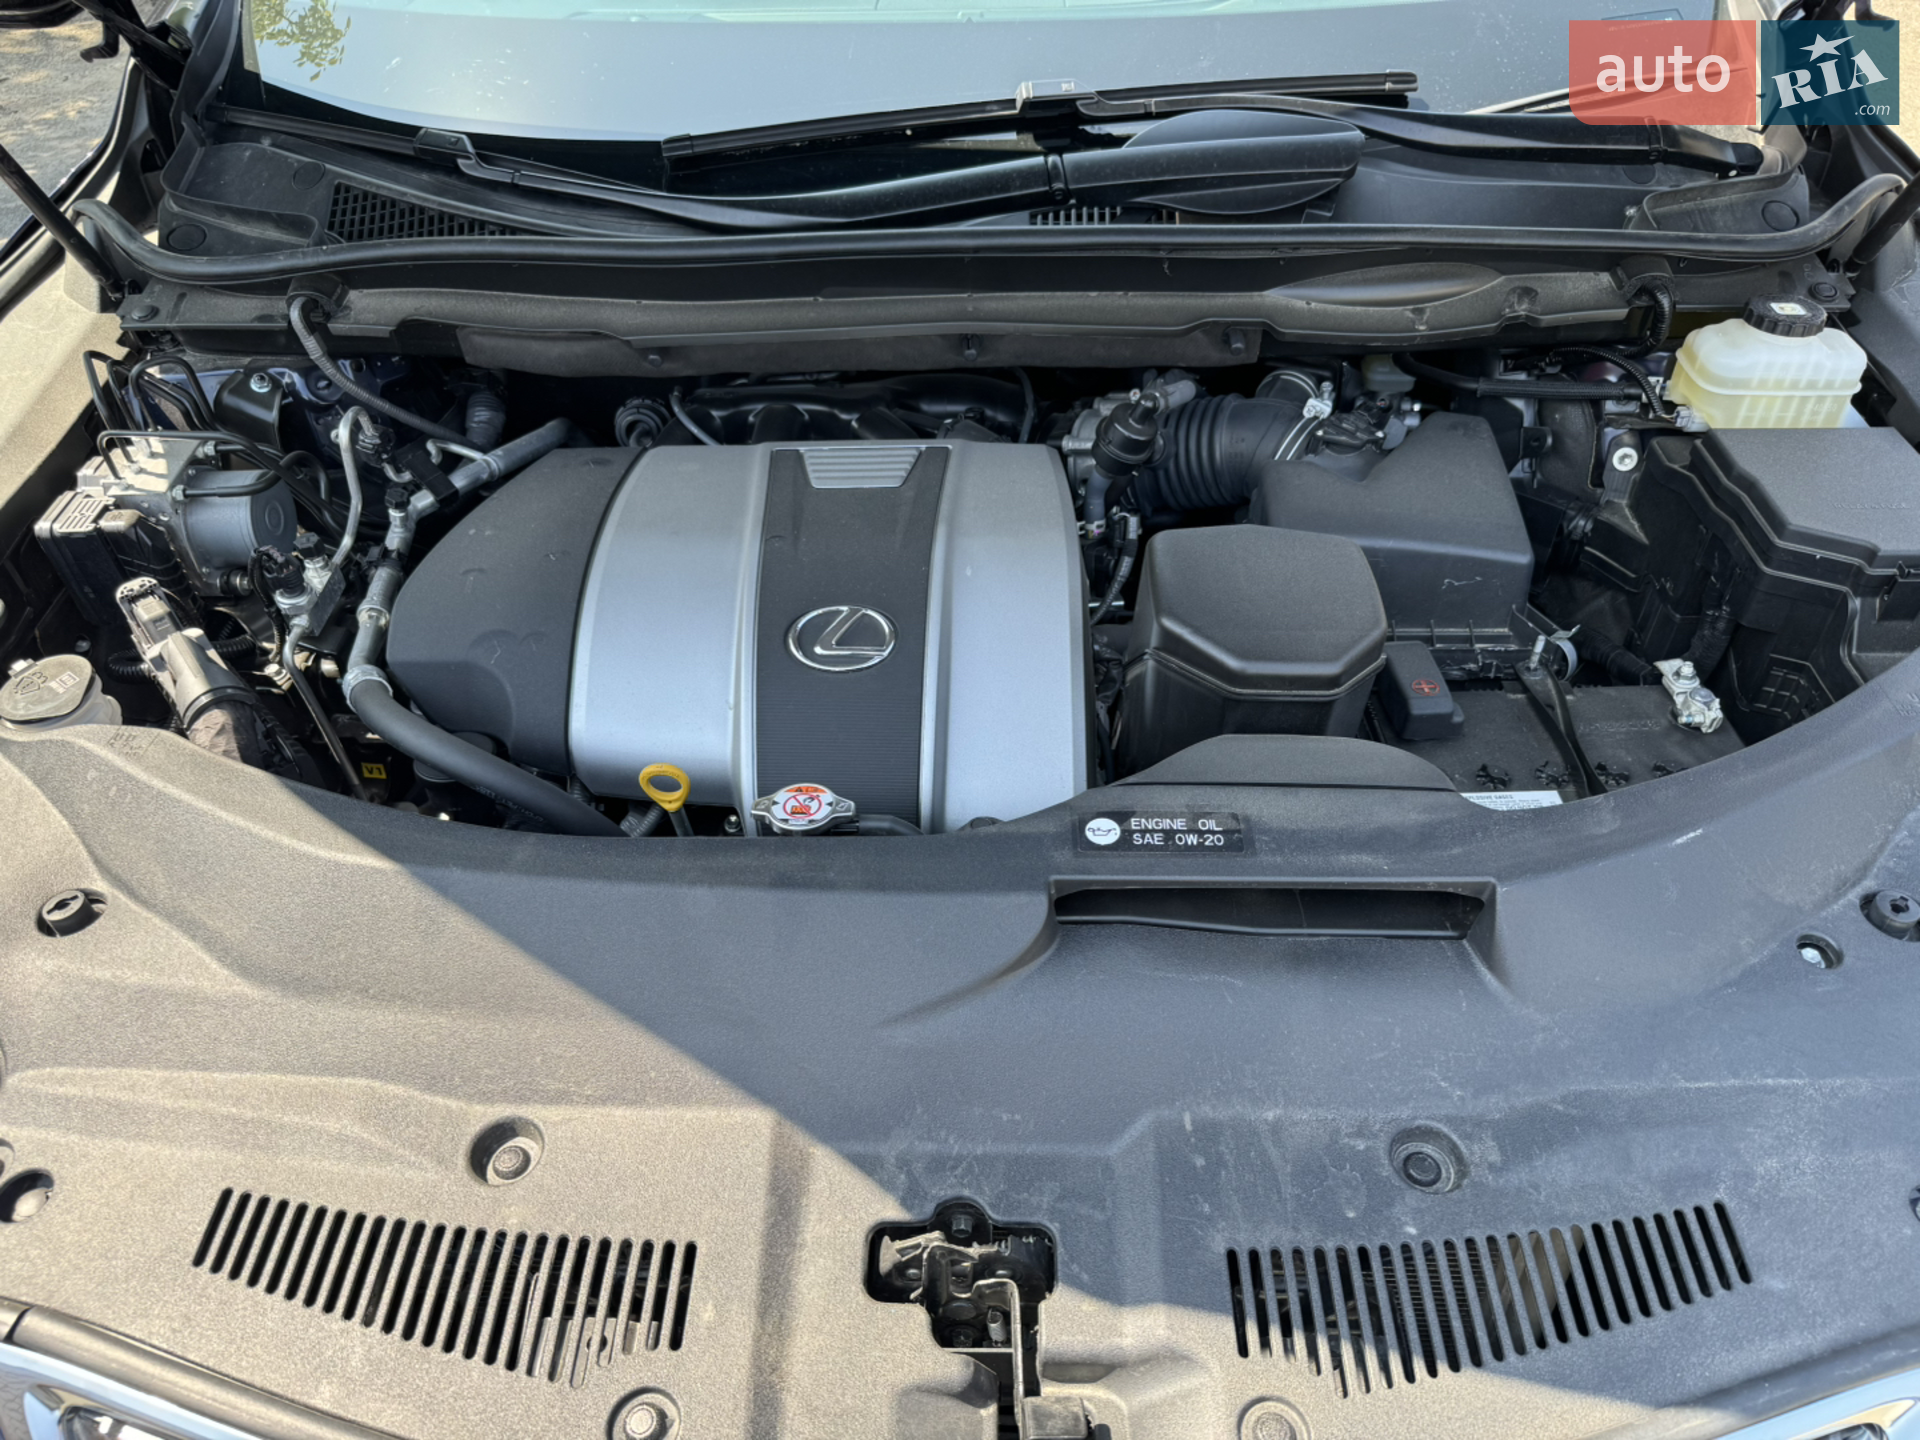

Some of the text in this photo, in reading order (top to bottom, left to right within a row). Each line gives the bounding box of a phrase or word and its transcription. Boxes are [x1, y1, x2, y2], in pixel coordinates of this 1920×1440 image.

[1130, 818, 1223, 831] ENGINE OIL
[1133, 833, 1224, 846] SAE 0W-20
